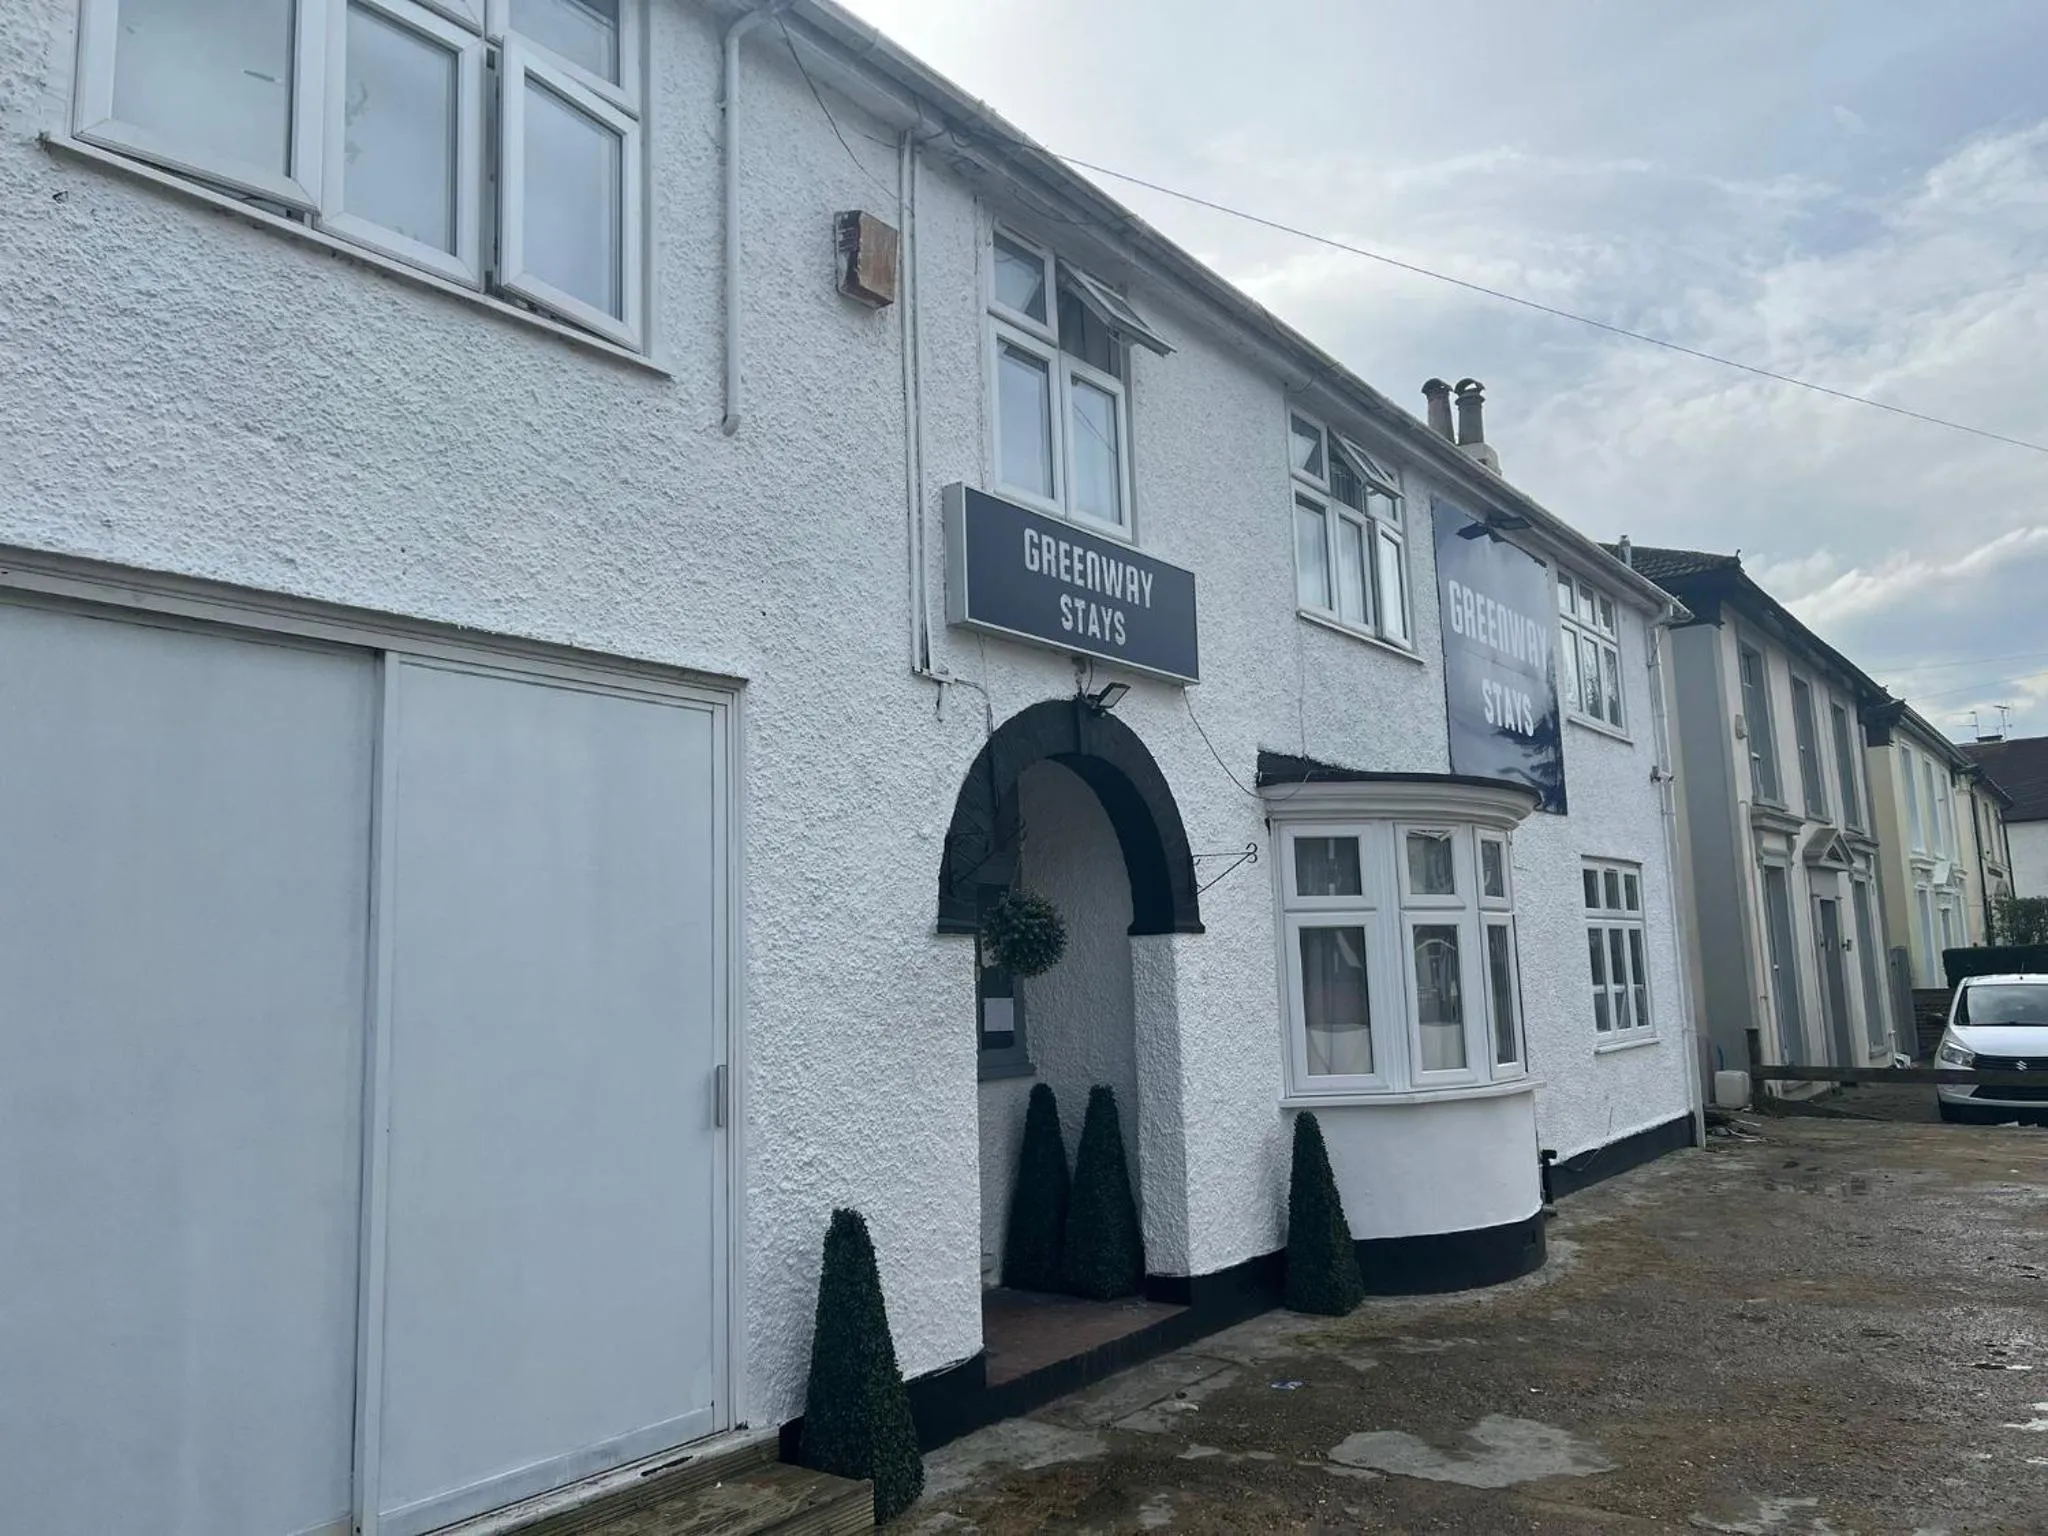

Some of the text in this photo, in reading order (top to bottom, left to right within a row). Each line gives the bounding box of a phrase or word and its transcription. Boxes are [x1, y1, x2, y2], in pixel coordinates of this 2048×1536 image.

[1023, 527, 1153, 608] GREENWAY
[1060, 593, 1126, 646] STAYS
[1448, 579, 1549, 671] GREENWAY
[1481, 678, 1534, 737] STAYS
